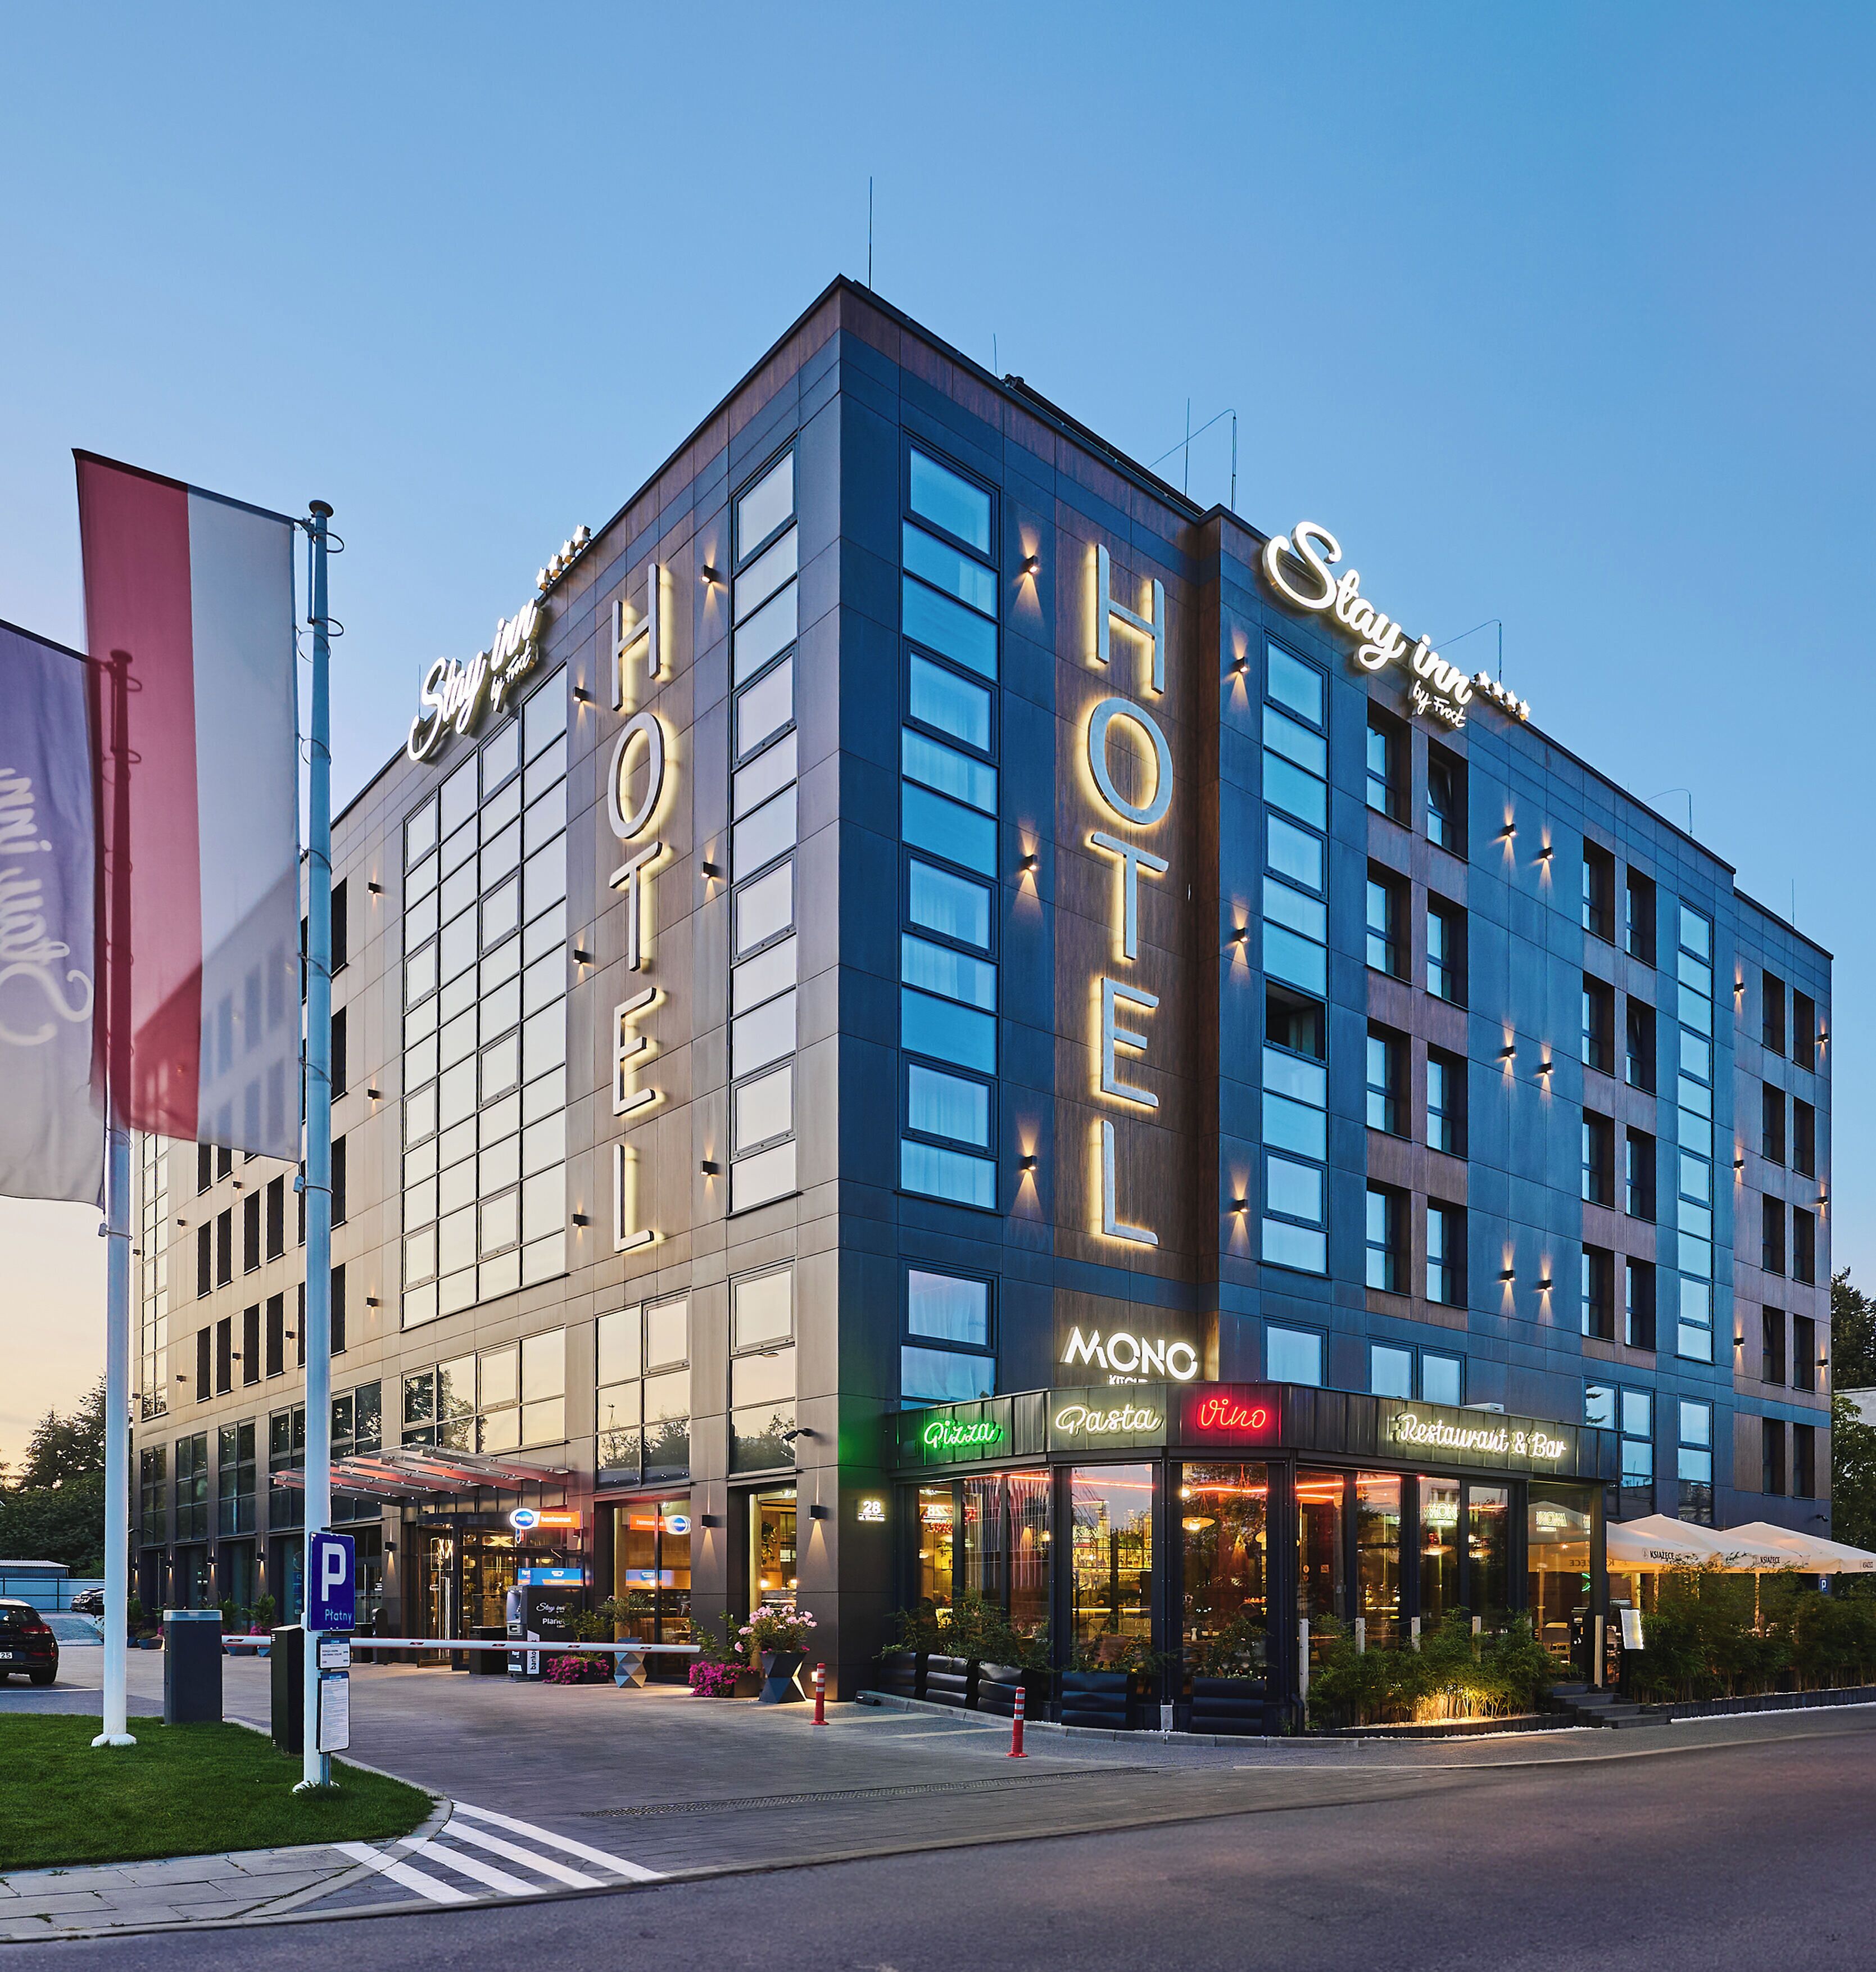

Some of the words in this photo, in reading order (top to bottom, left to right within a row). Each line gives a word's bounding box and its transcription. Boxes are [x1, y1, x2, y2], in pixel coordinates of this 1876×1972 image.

[1263, 521, 1407, 670] Stay
[1412, 634, 1472, 705] inn
[407, 650, 488, 761] Stay
[490, 597, 538, 672] inn
[490, 676, 504, 712] by
[1412, 680, 1433, 715] by
[1434, 696, 1466, 728] Frost
[608, 563, 665, 1252] HOTEL
[1087, 543, 1173, 1246] HOTEL
[1061, 1326, 1198, 1381] MONO
[1055, 1404, 1161, 1435] Pasta
[1200, 1399, 1266, 1428] Vino
[924, 1421, 996, 1448] Pizza
[1398, 1414, 1508, 1451] Restaurant
[1515, 1431, 1525, 1454] &
[1531, 1433, 1567, 1458] Bar
[863, 1500, 881, 1514] 28
[321, 1543, 346, 1601] P
[1650, 1550, 1674, 1562] KSIĄŻĘCE
[325, 1609, 352, 1625] Płatny
[536, 1602, 555, 1613] Stay
